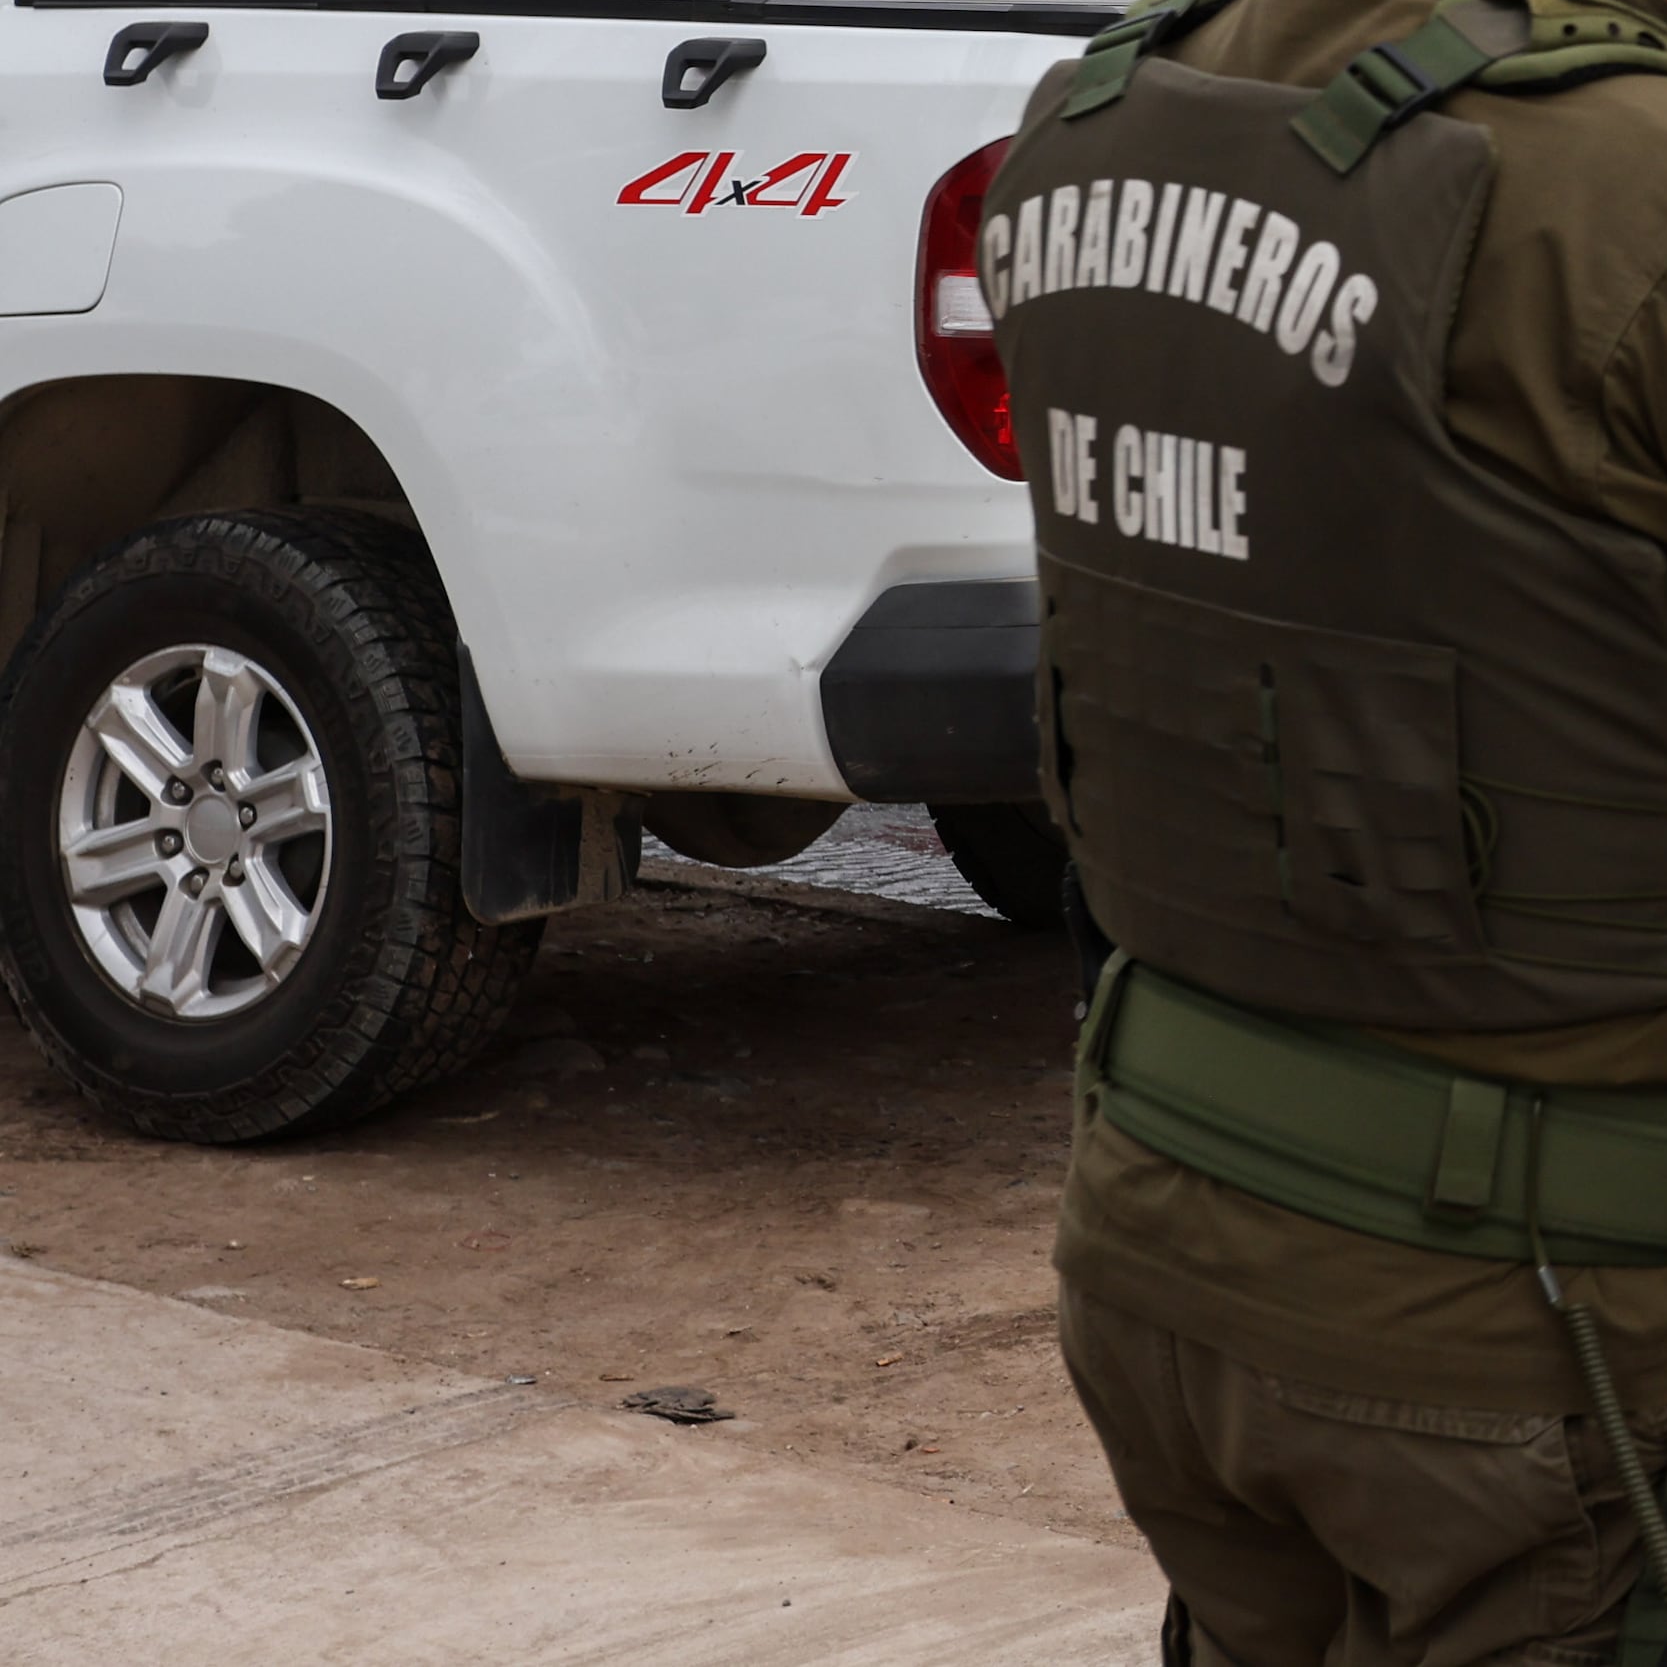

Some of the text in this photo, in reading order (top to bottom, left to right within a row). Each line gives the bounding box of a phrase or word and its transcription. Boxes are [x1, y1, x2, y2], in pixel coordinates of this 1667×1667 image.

[617, 152, 853, 216] 4x4
[983, 179, 1379, 387] CARABINEROS
[1048, 407, 1250, 561] DE CHILE
